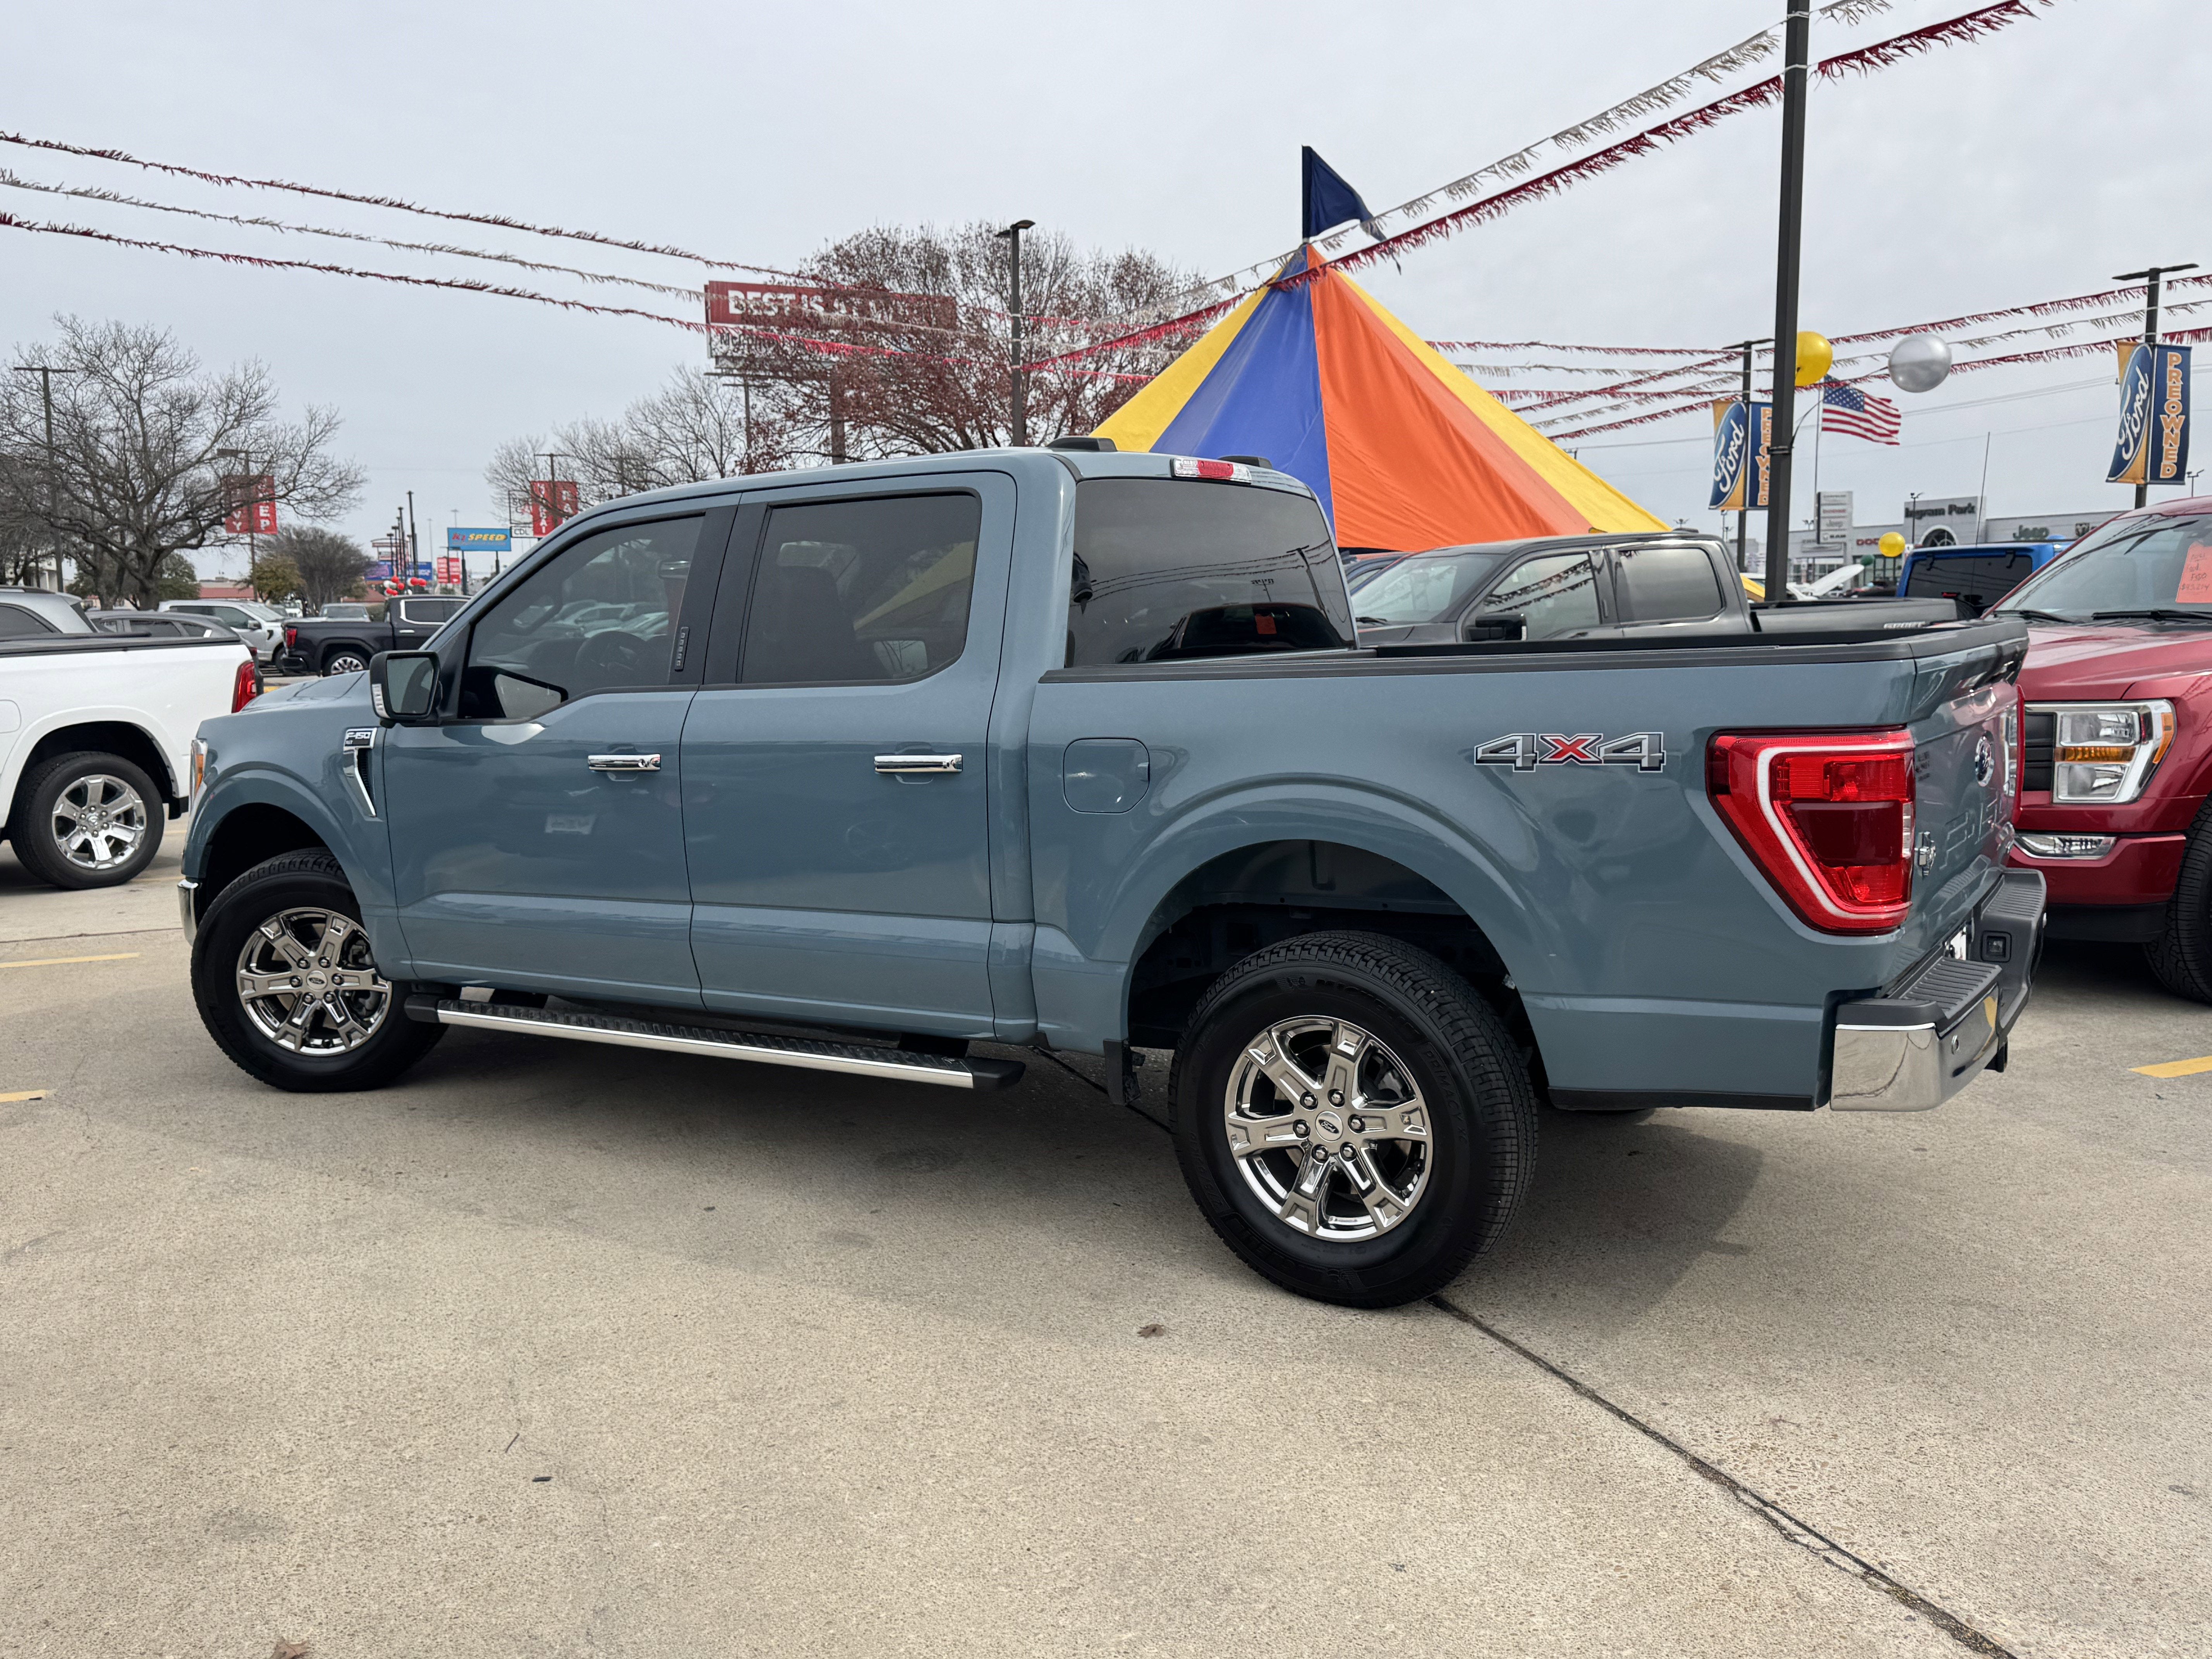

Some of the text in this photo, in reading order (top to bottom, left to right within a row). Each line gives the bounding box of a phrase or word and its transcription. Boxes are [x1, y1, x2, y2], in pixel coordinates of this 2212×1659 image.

[728, 290, 796, 316] BEST
[2117, 366, 2149, 460] Ford
[2159, 352, 2185, 478] PREOWNED
[1714, 419, 1744, 493] Ford
[1905, 502, 1975, 520] Ingram Park
[2013, 525, 2049, 539] Jeep
[347, 732, 371, 740] F-150
[1474, 732, 1666, 773] 4X4
